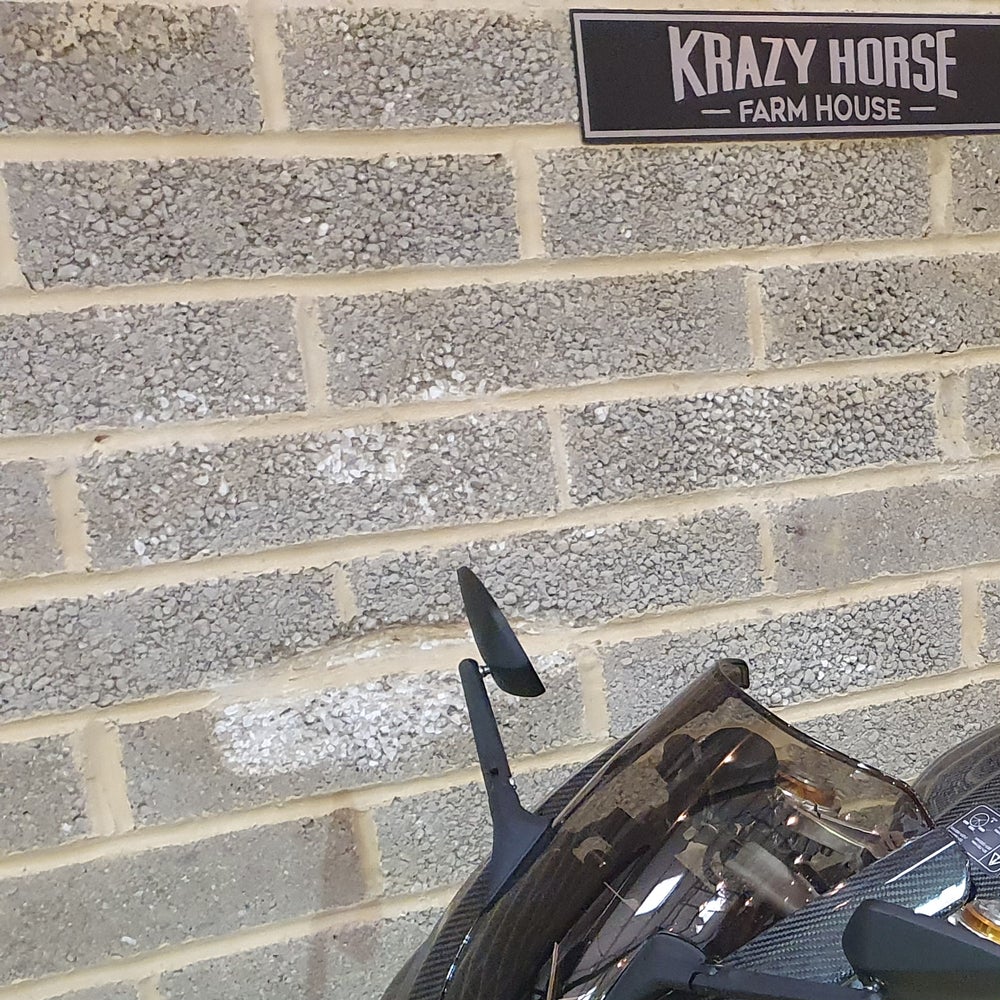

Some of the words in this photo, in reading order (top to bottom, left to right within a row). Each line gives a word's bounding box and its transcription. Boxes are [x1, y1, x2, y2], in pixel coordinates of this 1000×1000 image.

[668, 25, 817, 102] KRAZY
[829, 29, 958, 99] HORSE
[739, 95, 807, 122] FARM
[815, 93, 902, 121] HOUSE
